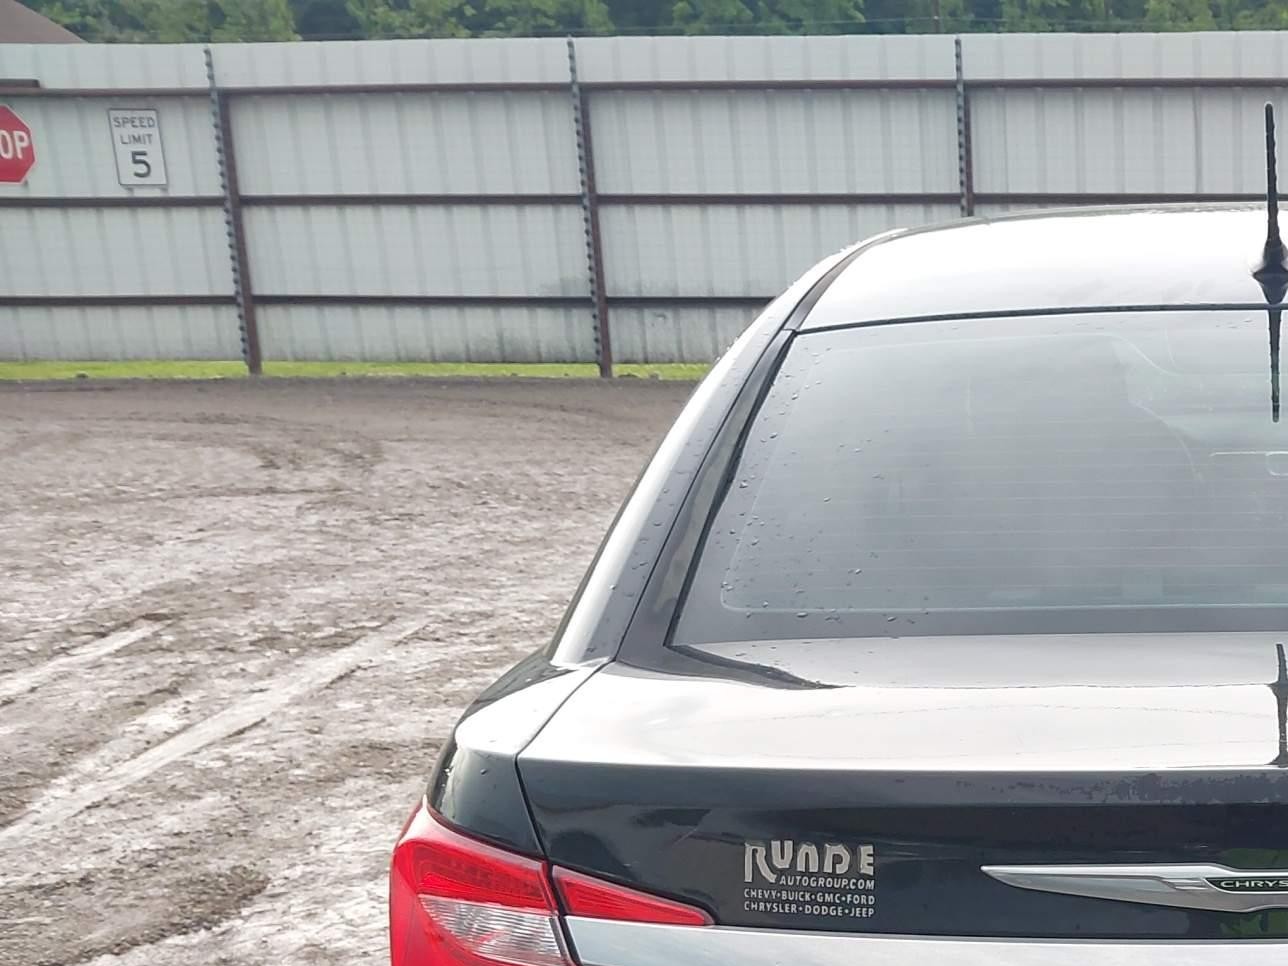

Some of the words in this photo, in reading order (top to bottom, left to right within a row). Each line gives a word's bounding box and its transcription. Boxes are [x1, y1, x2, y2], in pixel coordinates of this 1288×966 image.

[113, 116, 156, 128] SPEED
[119, 133, 153, 145] LIMIT
[131, 150, 151, 178] 5
[744, 840, 874, 883] RUNDE
[779, 875, 875, 891] AUTOGROUP.COM
